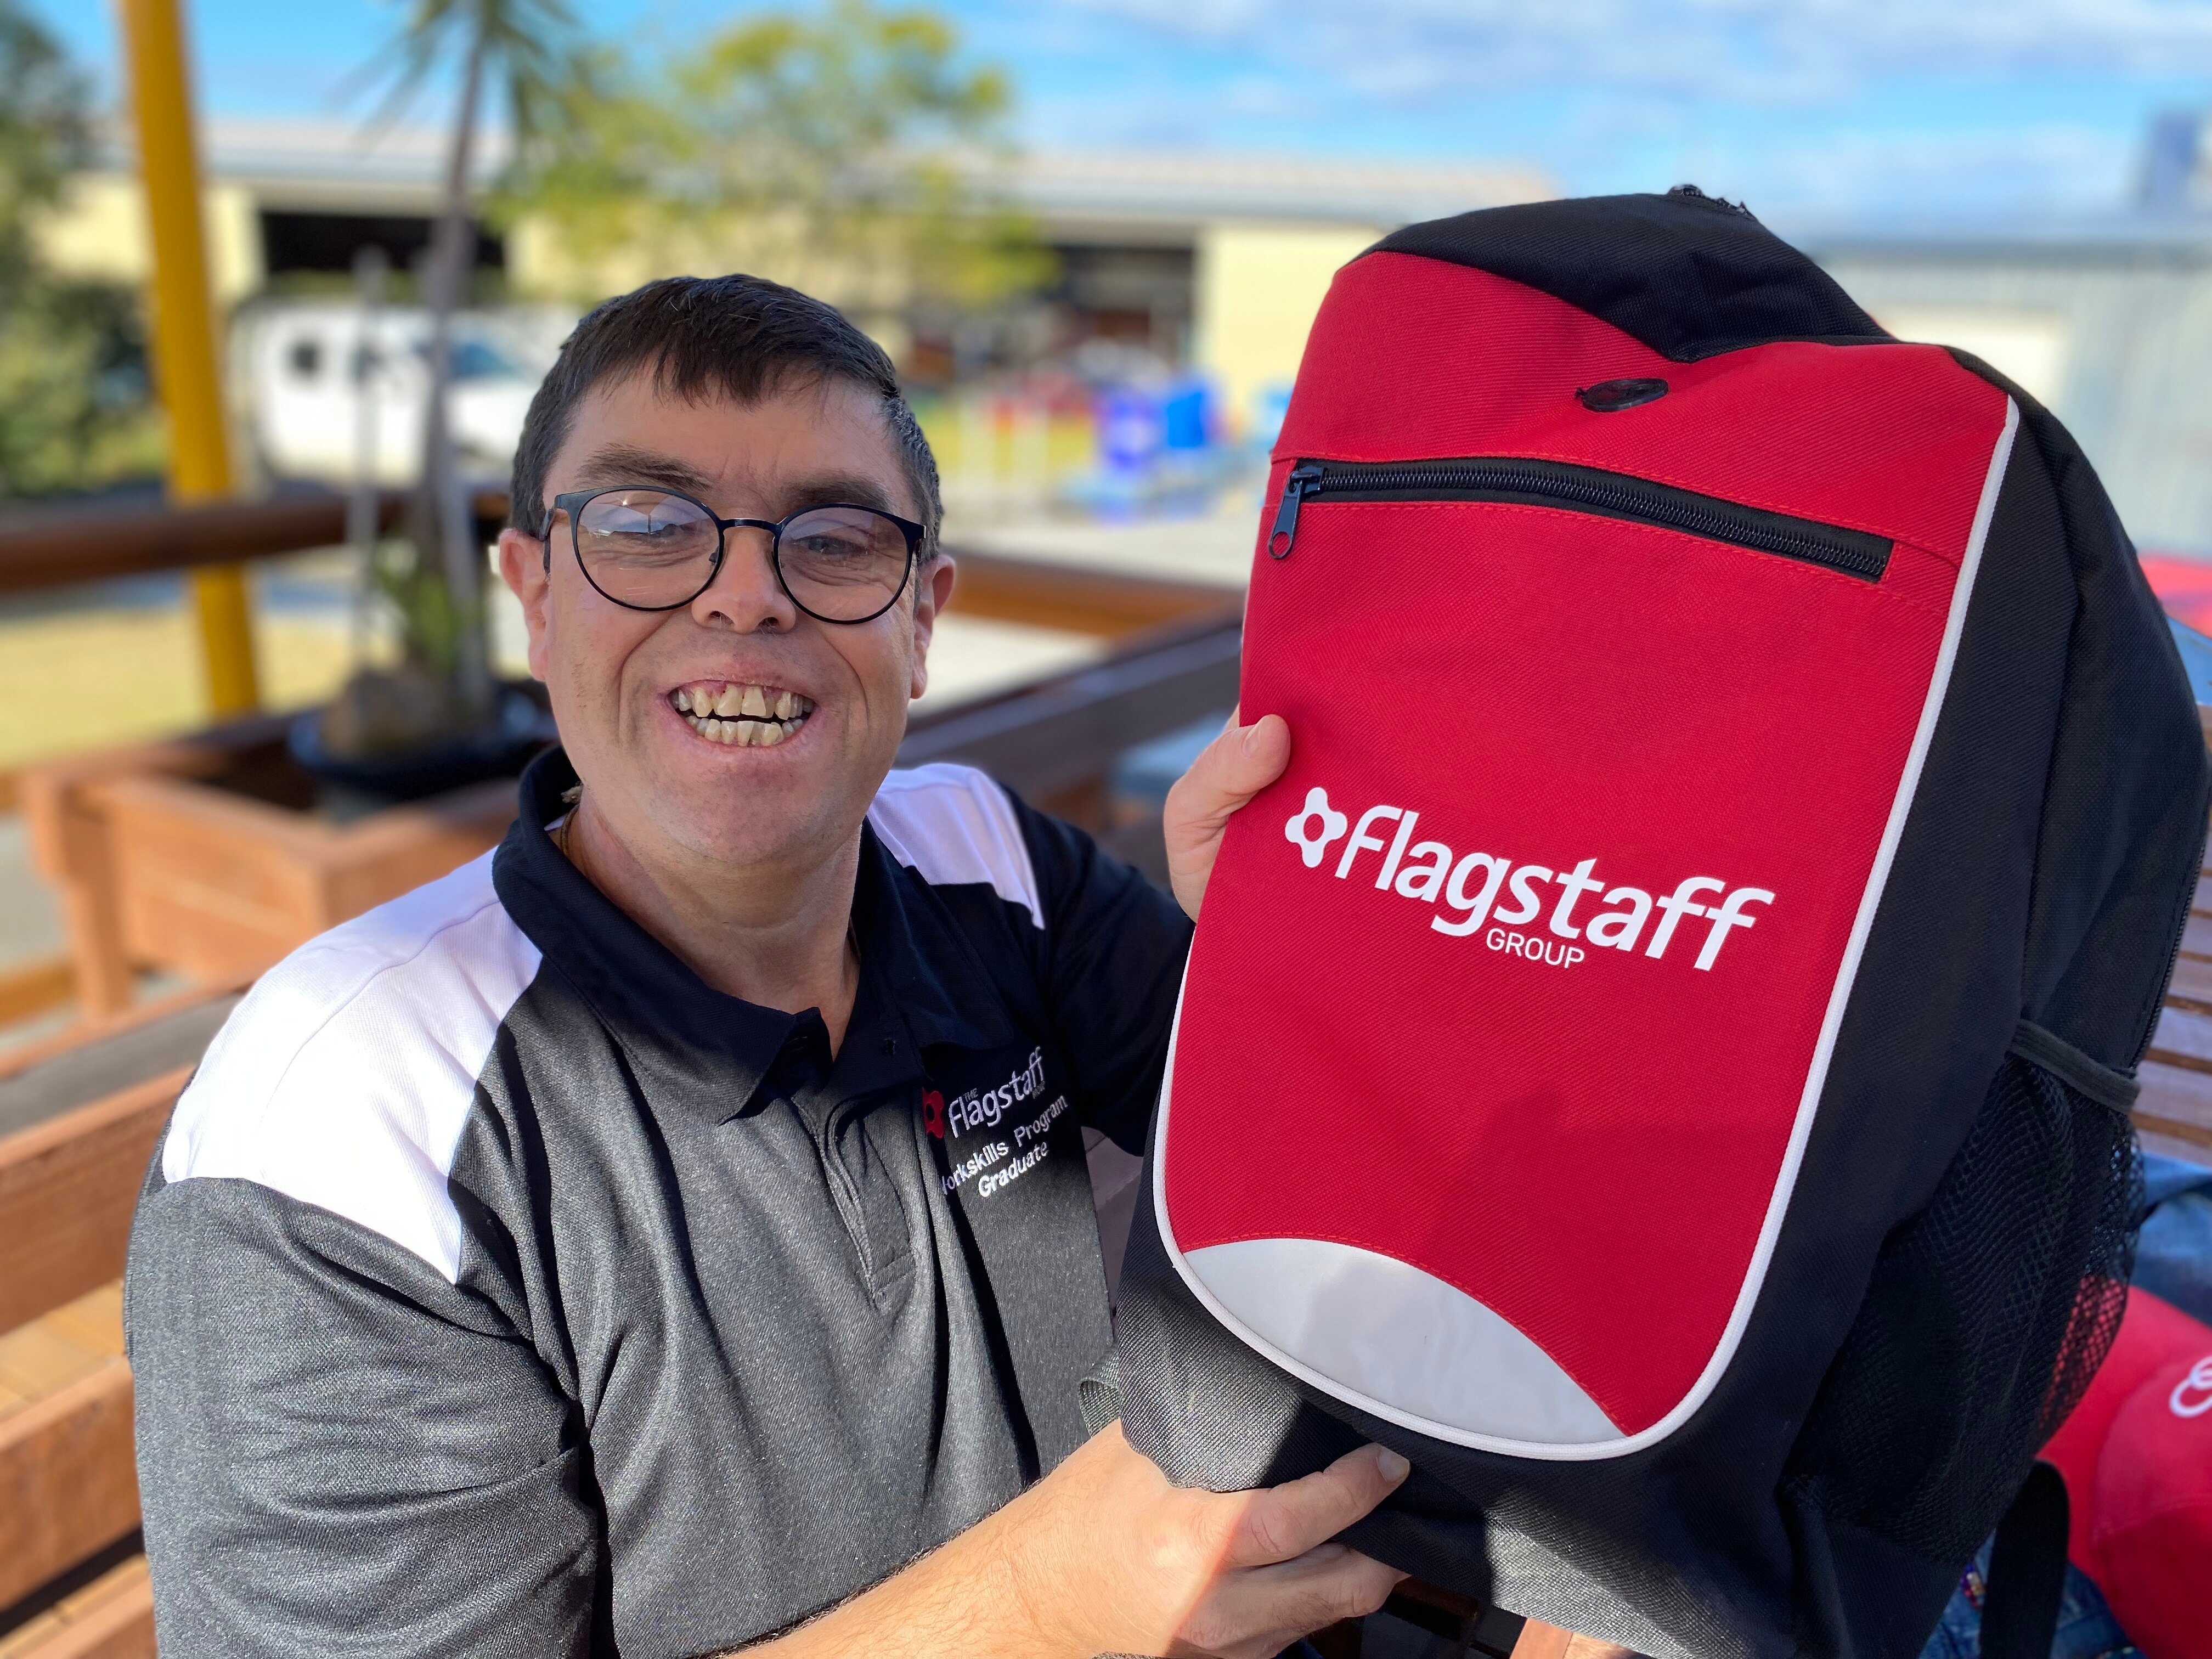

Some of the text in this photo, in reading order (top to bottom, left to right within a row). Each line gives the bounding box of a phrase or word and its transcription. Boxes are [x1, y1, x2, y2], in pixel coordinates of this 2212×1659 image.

[1486, 928, 1584, 969] GROUP
[1014, 1096, 1068, 1147] Program
[979, 1142, 1048, 1197] Graduate
